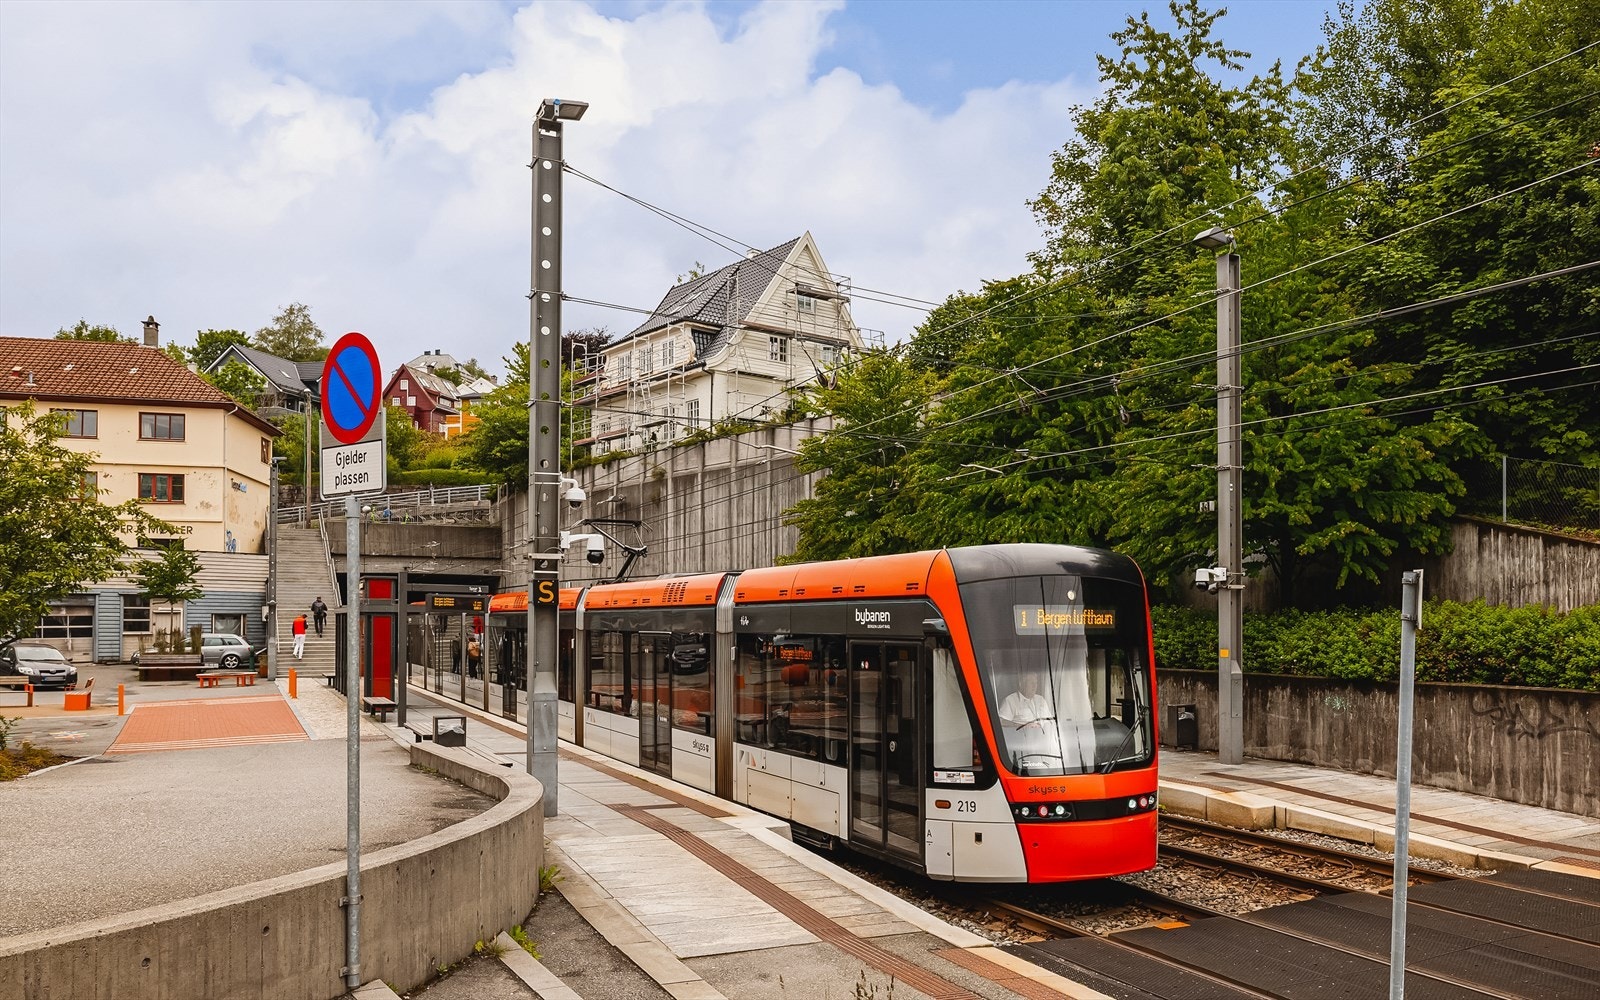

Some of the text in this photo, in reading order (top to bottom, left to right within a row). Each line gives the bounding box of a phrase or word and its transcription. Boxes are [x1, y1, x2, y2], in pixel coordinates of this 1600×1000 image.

[335, 450, 367, 469] Gjelder
[335, 472, 369, 489] plassen
[538, 581, 554, 603] S
[855, 608, 891, 625] bybanen
[1021, 611, 1027, 627] 1
[1037, 609, 1072, 629] Bergen
[1028, 785, 1058, 795] skyss
[957, 800, 977, 813] 219
[926, 829, 932, 838] A
